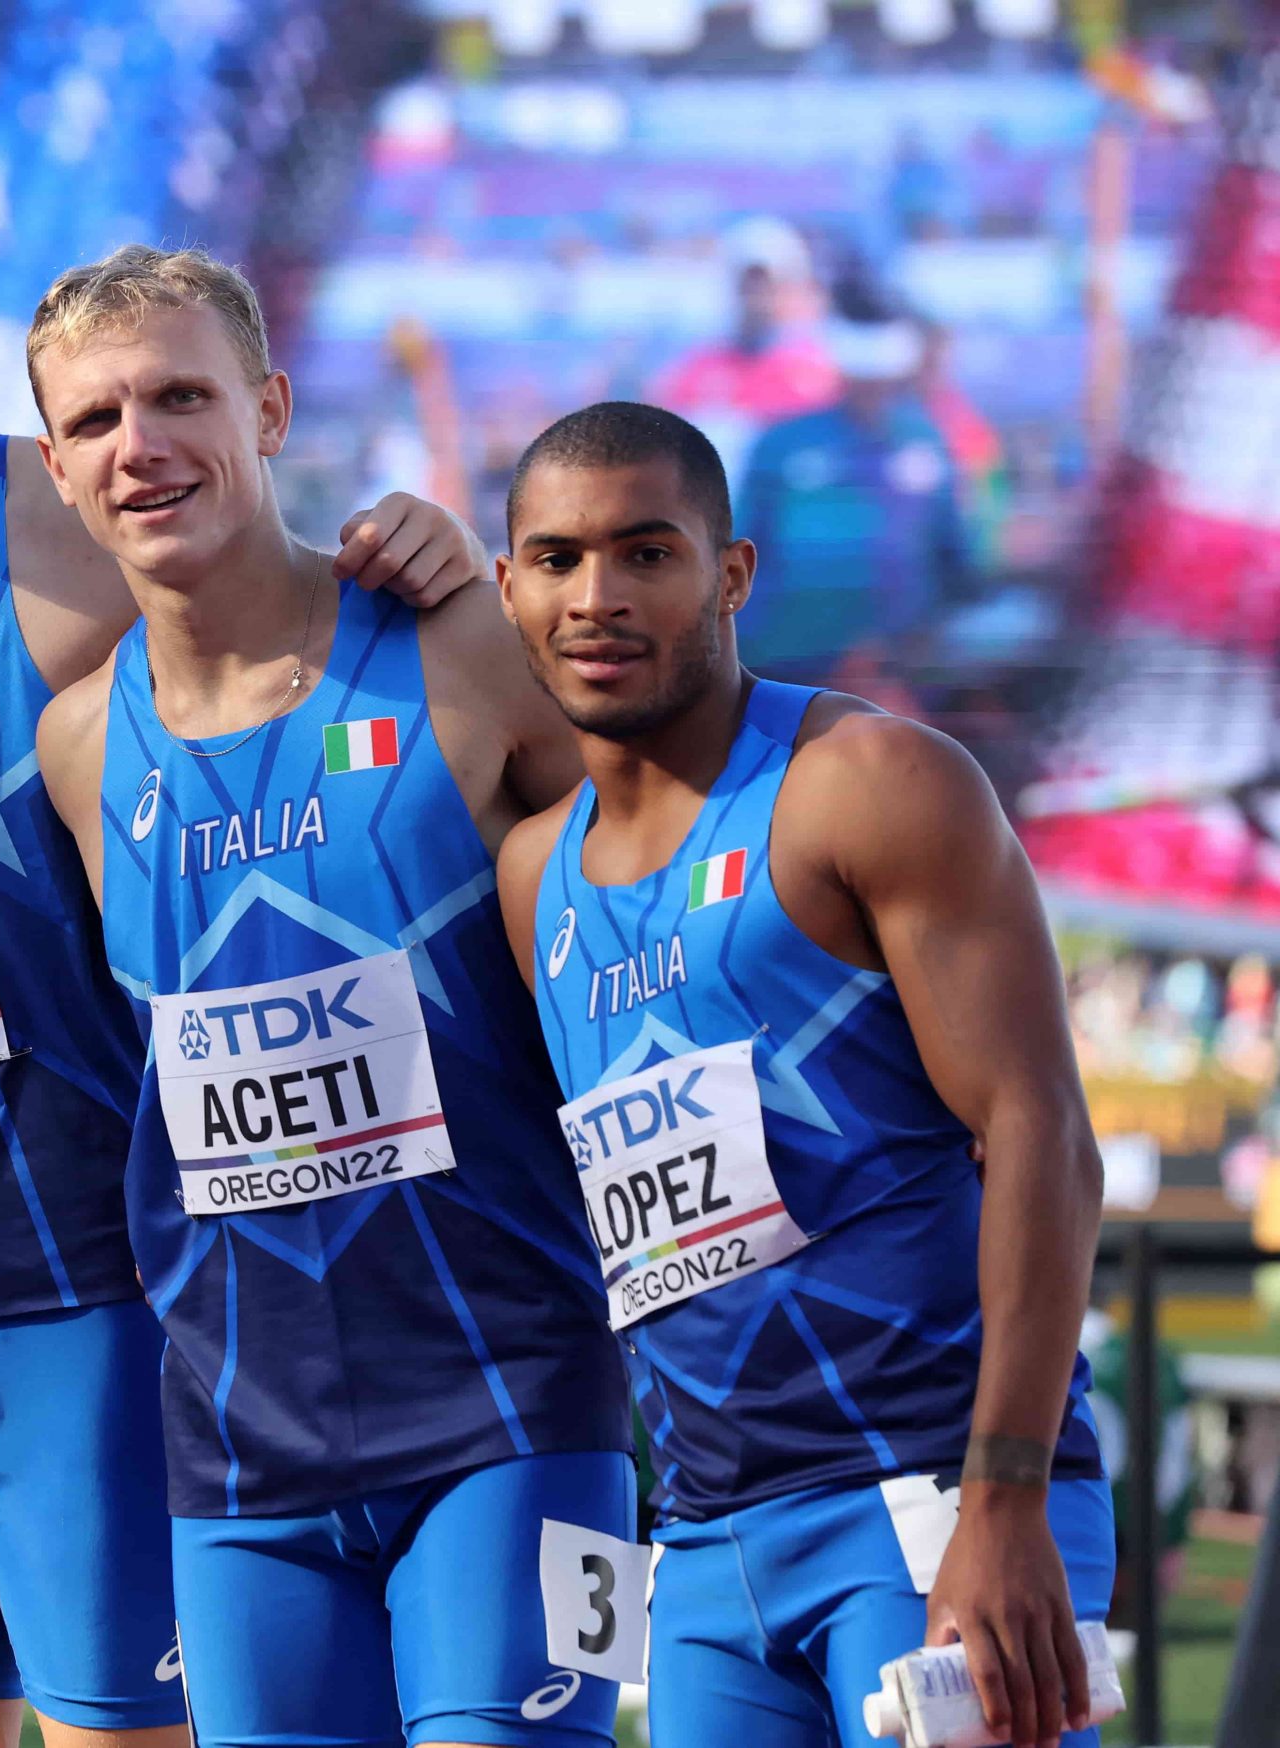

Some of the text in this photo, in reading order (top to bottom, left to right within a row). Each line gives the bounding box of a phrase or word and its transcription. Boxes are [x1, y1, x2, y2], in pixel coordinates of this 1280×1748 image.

[180, 796, 325, 877] ITALIA
[205, 976, 375, 1056] TDK
[588, 935, 687, 1019] ITALIA
[203, 1054, 380, 1148] ACETI
[581, 1066, 715, 1159] TDK
[208, 1144, 404, 1207] OREGON22
[586, 1142, 733, 1260] LOPEZ
[622, 1238, 757, 1317] OREGON22
[578, 1554, 617, 1656] 3
